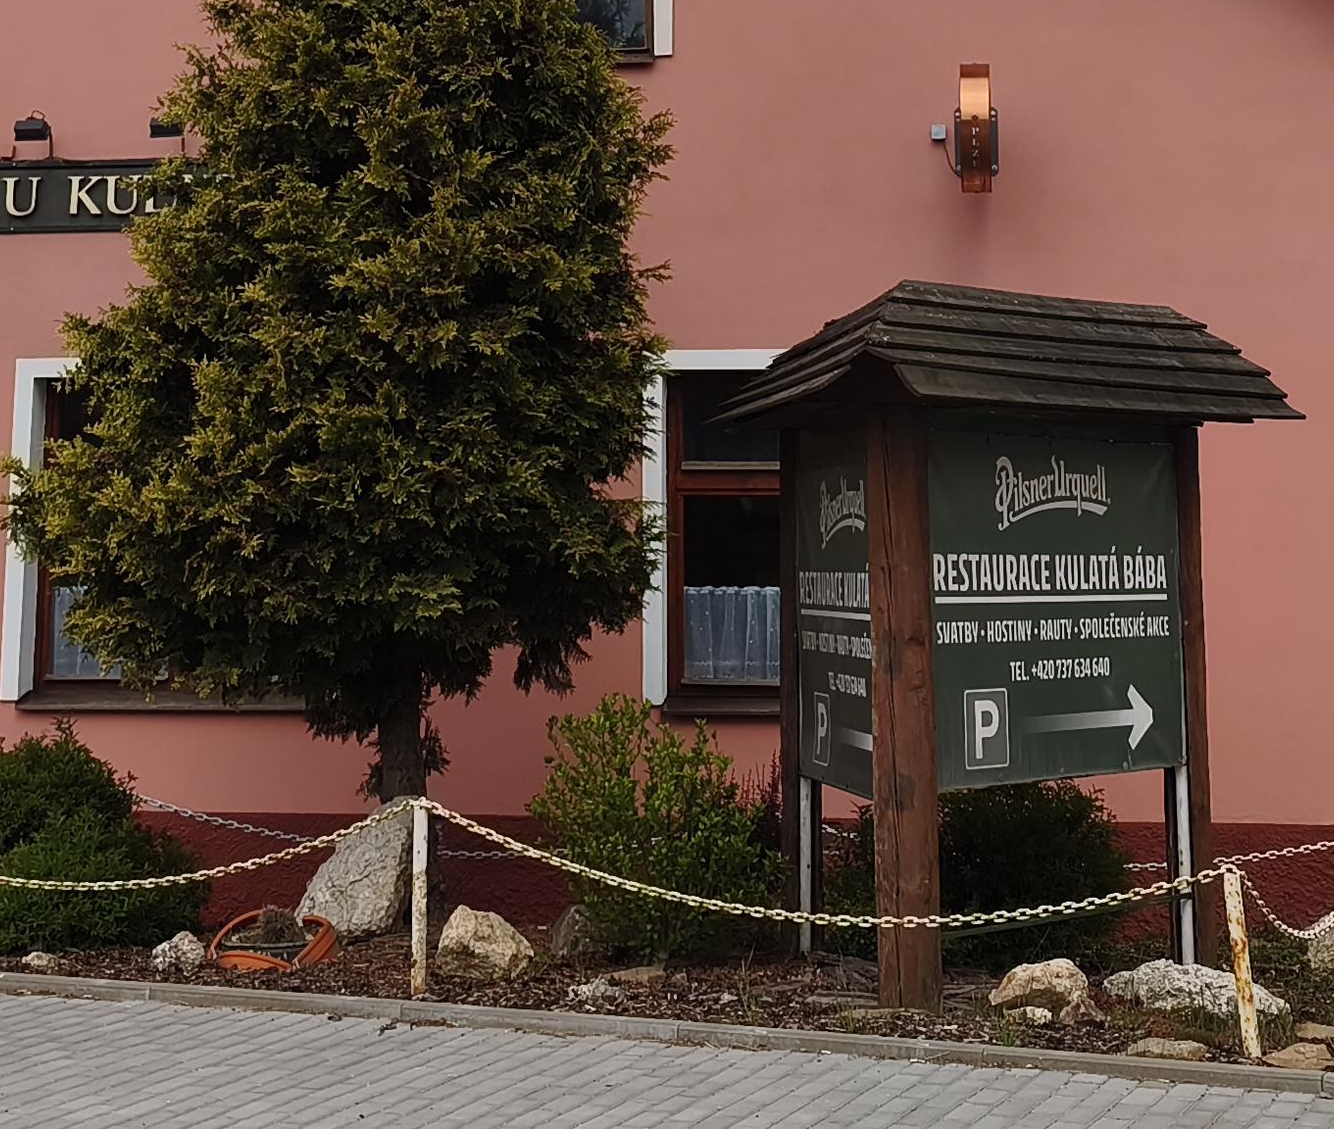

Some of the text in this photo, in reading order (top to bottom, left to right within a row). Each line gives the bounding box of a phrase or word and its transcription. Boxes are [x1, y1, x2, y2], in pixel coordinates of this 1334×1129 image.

[1, 176, 41, 217] U
[799, 562, 869, 608] RESTAURACE KULATÁ
[933, 545, 1167, 591] RESTAURACE KULATÁ BÁBA
[936, 611, 1169, 644] SVATBY HOSTINY RAUTY SPOLEČENSKÉ AKCE
[1009, 656, 1110, 681] TEL. +420 737 634 640
[817, 702, 828, 755] P
[974, 699, 1000, 759] P
